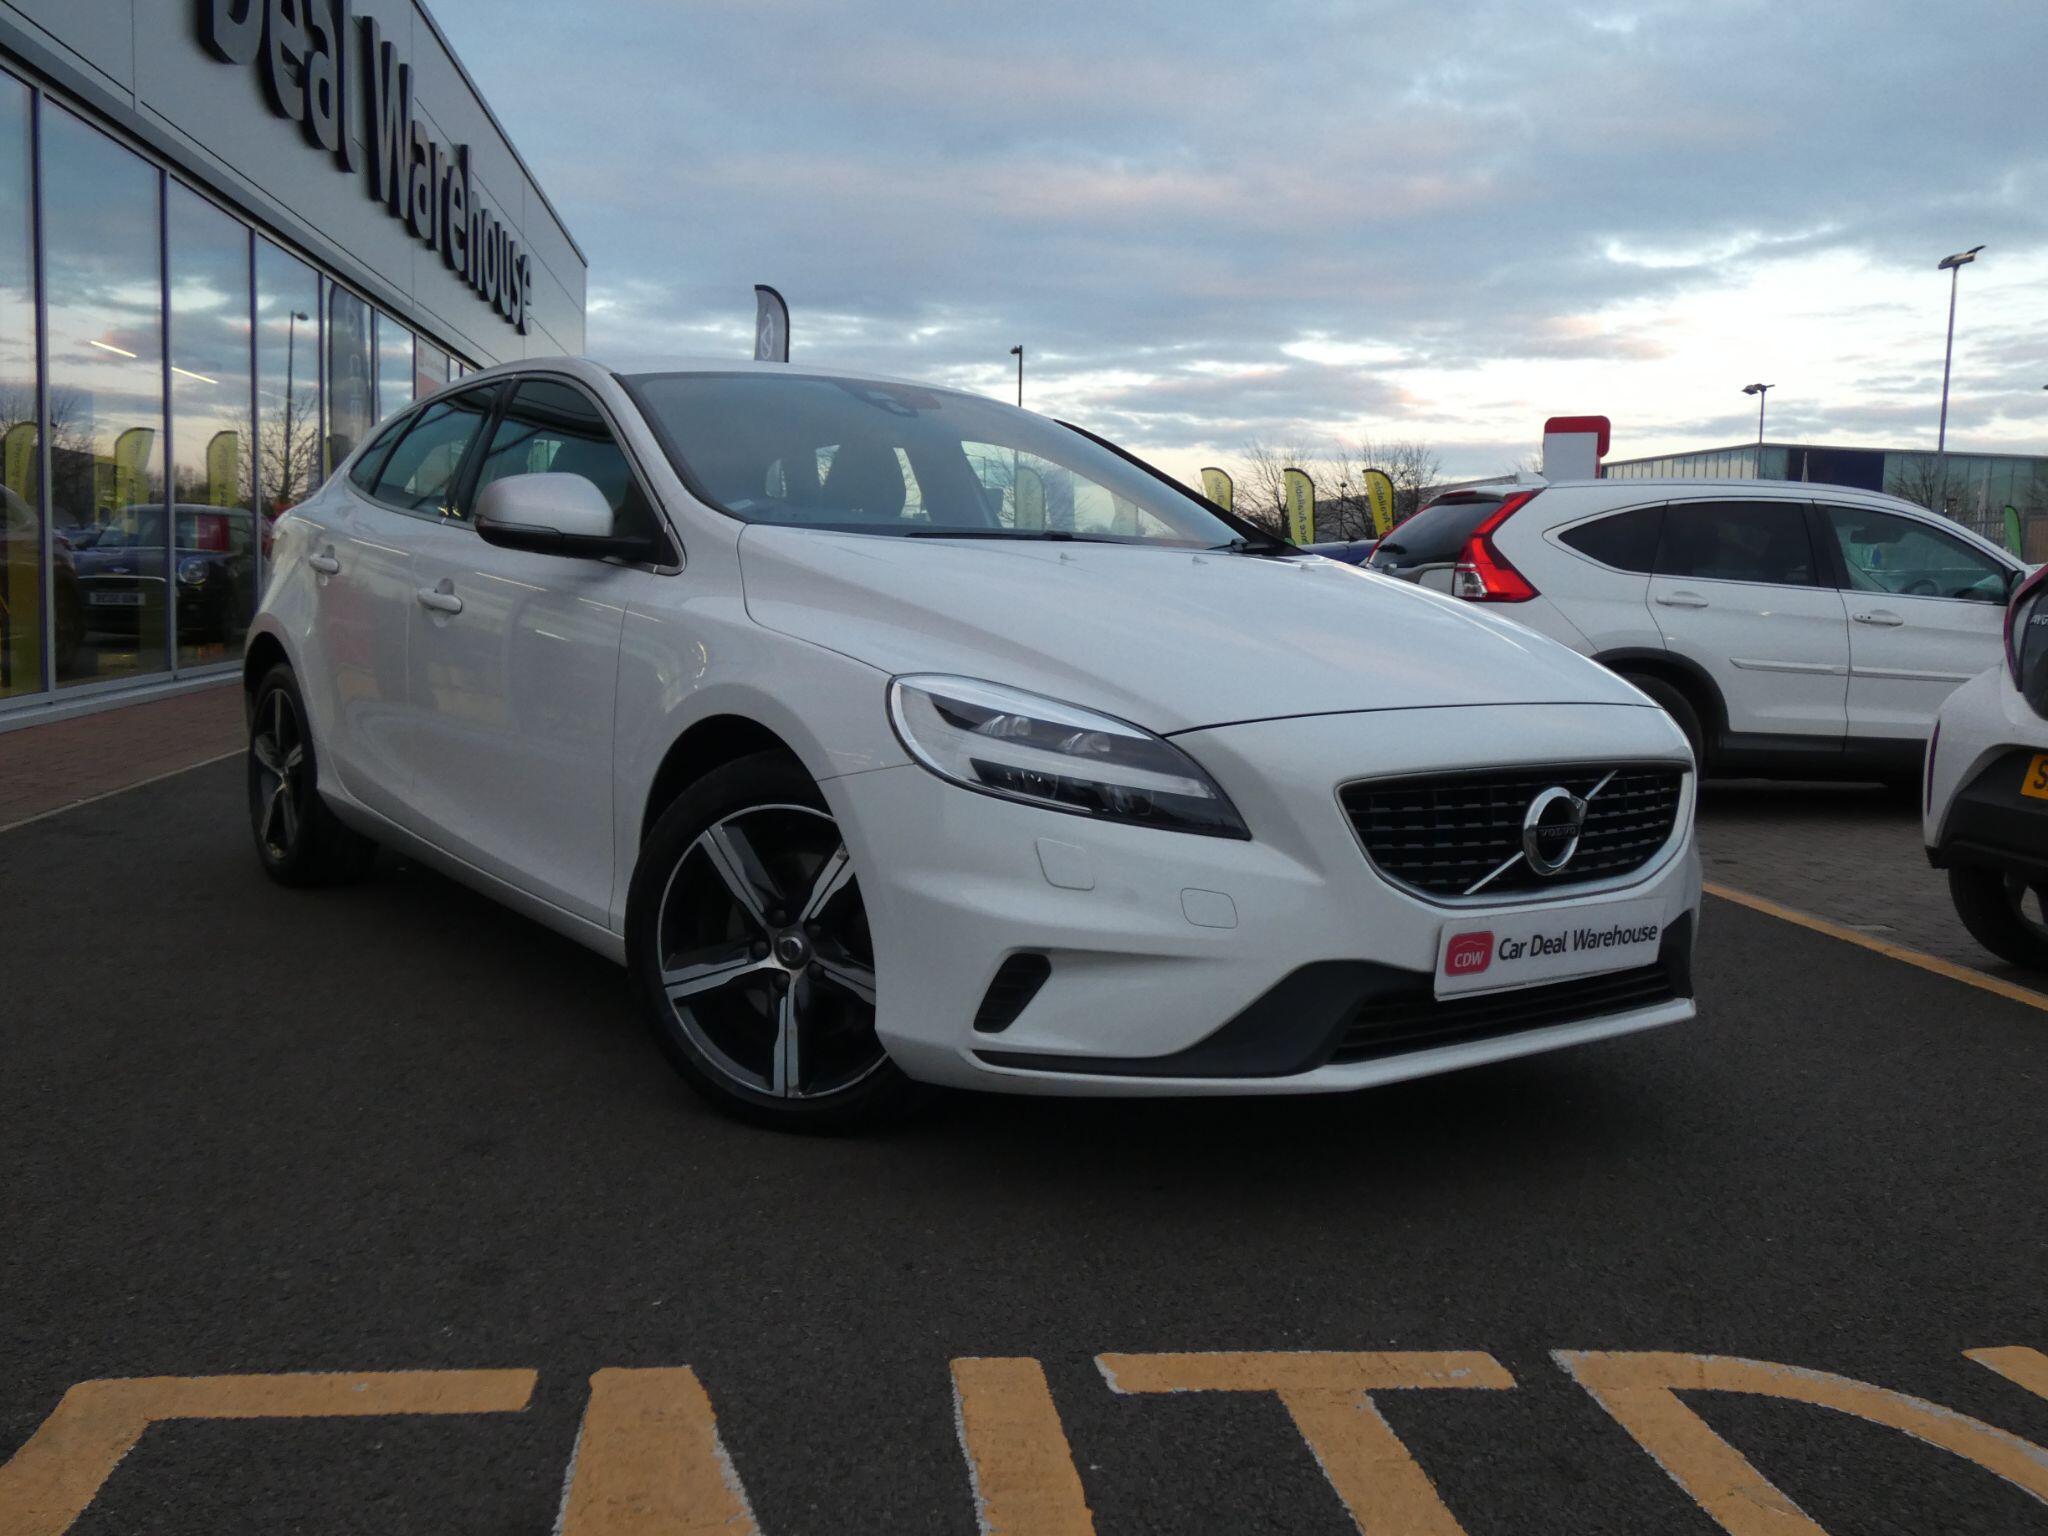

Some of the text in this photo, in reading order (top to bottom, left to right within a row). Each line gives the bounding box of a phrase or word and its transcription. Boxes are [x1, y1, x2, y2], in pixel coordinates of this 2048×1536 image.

[363, 16, 532, 336] Warehouse
[1455, 951, 1484, 968] CDW
[1498, 924, 1658, 961] Car Deal Warehouse
